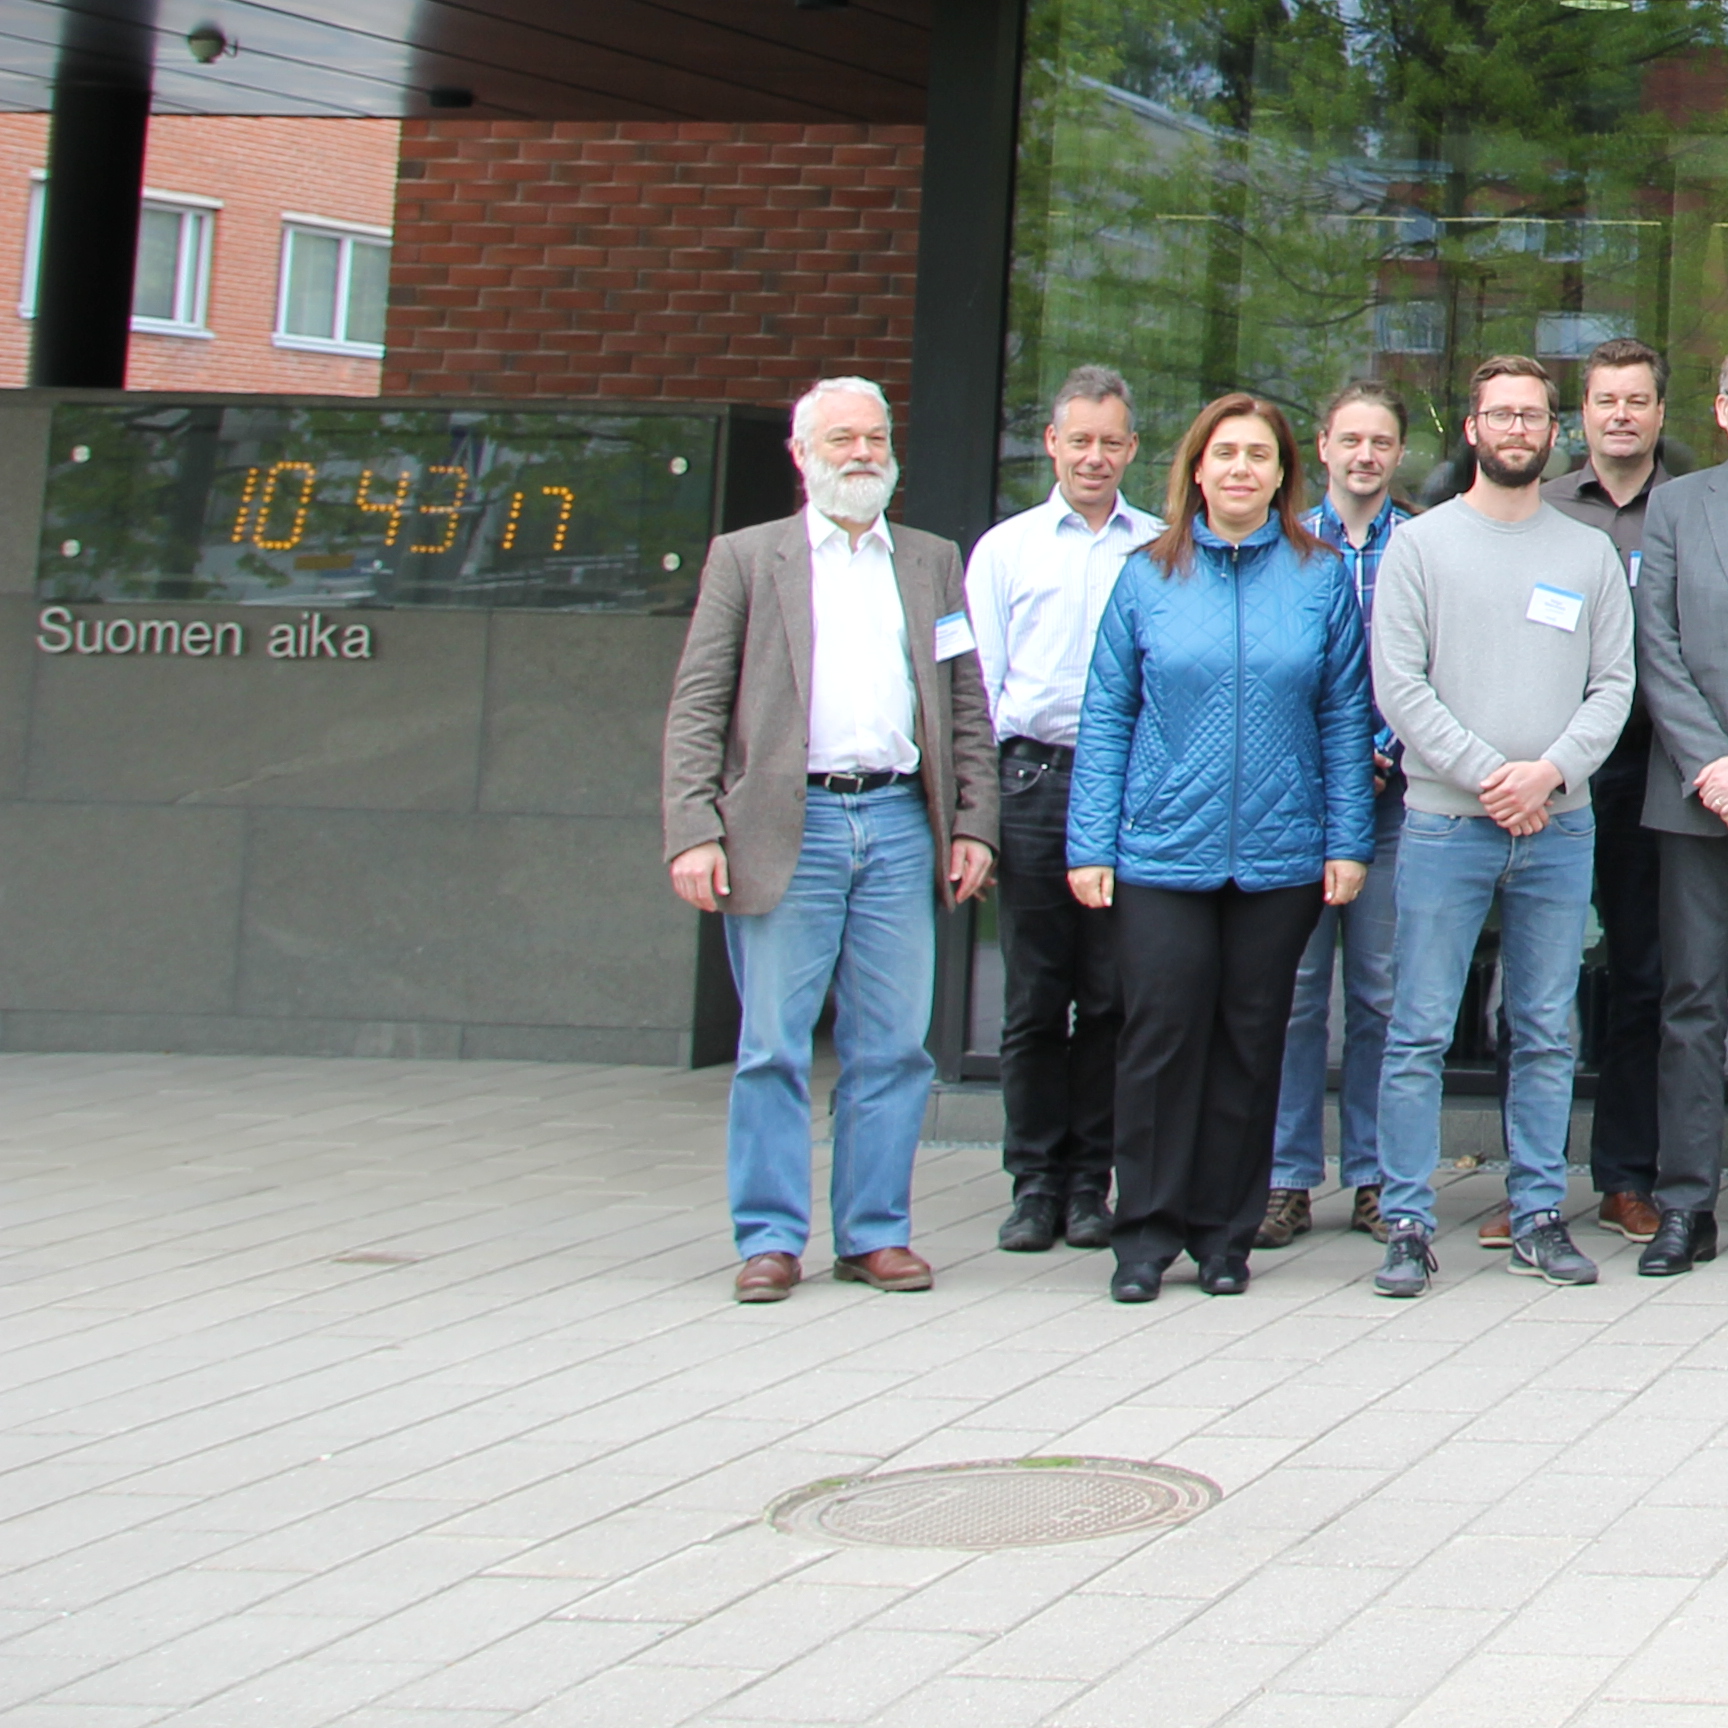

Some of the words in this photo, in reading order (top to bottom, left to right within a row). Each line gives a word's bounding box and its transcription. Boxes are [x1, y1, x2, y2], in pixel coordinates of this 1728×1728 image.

[230, 460, 317, 551] 10
[355, 464, 469, 554] 43
[36, 606, 243, 656] Suomen
[266, 612, 373, 660] aika
